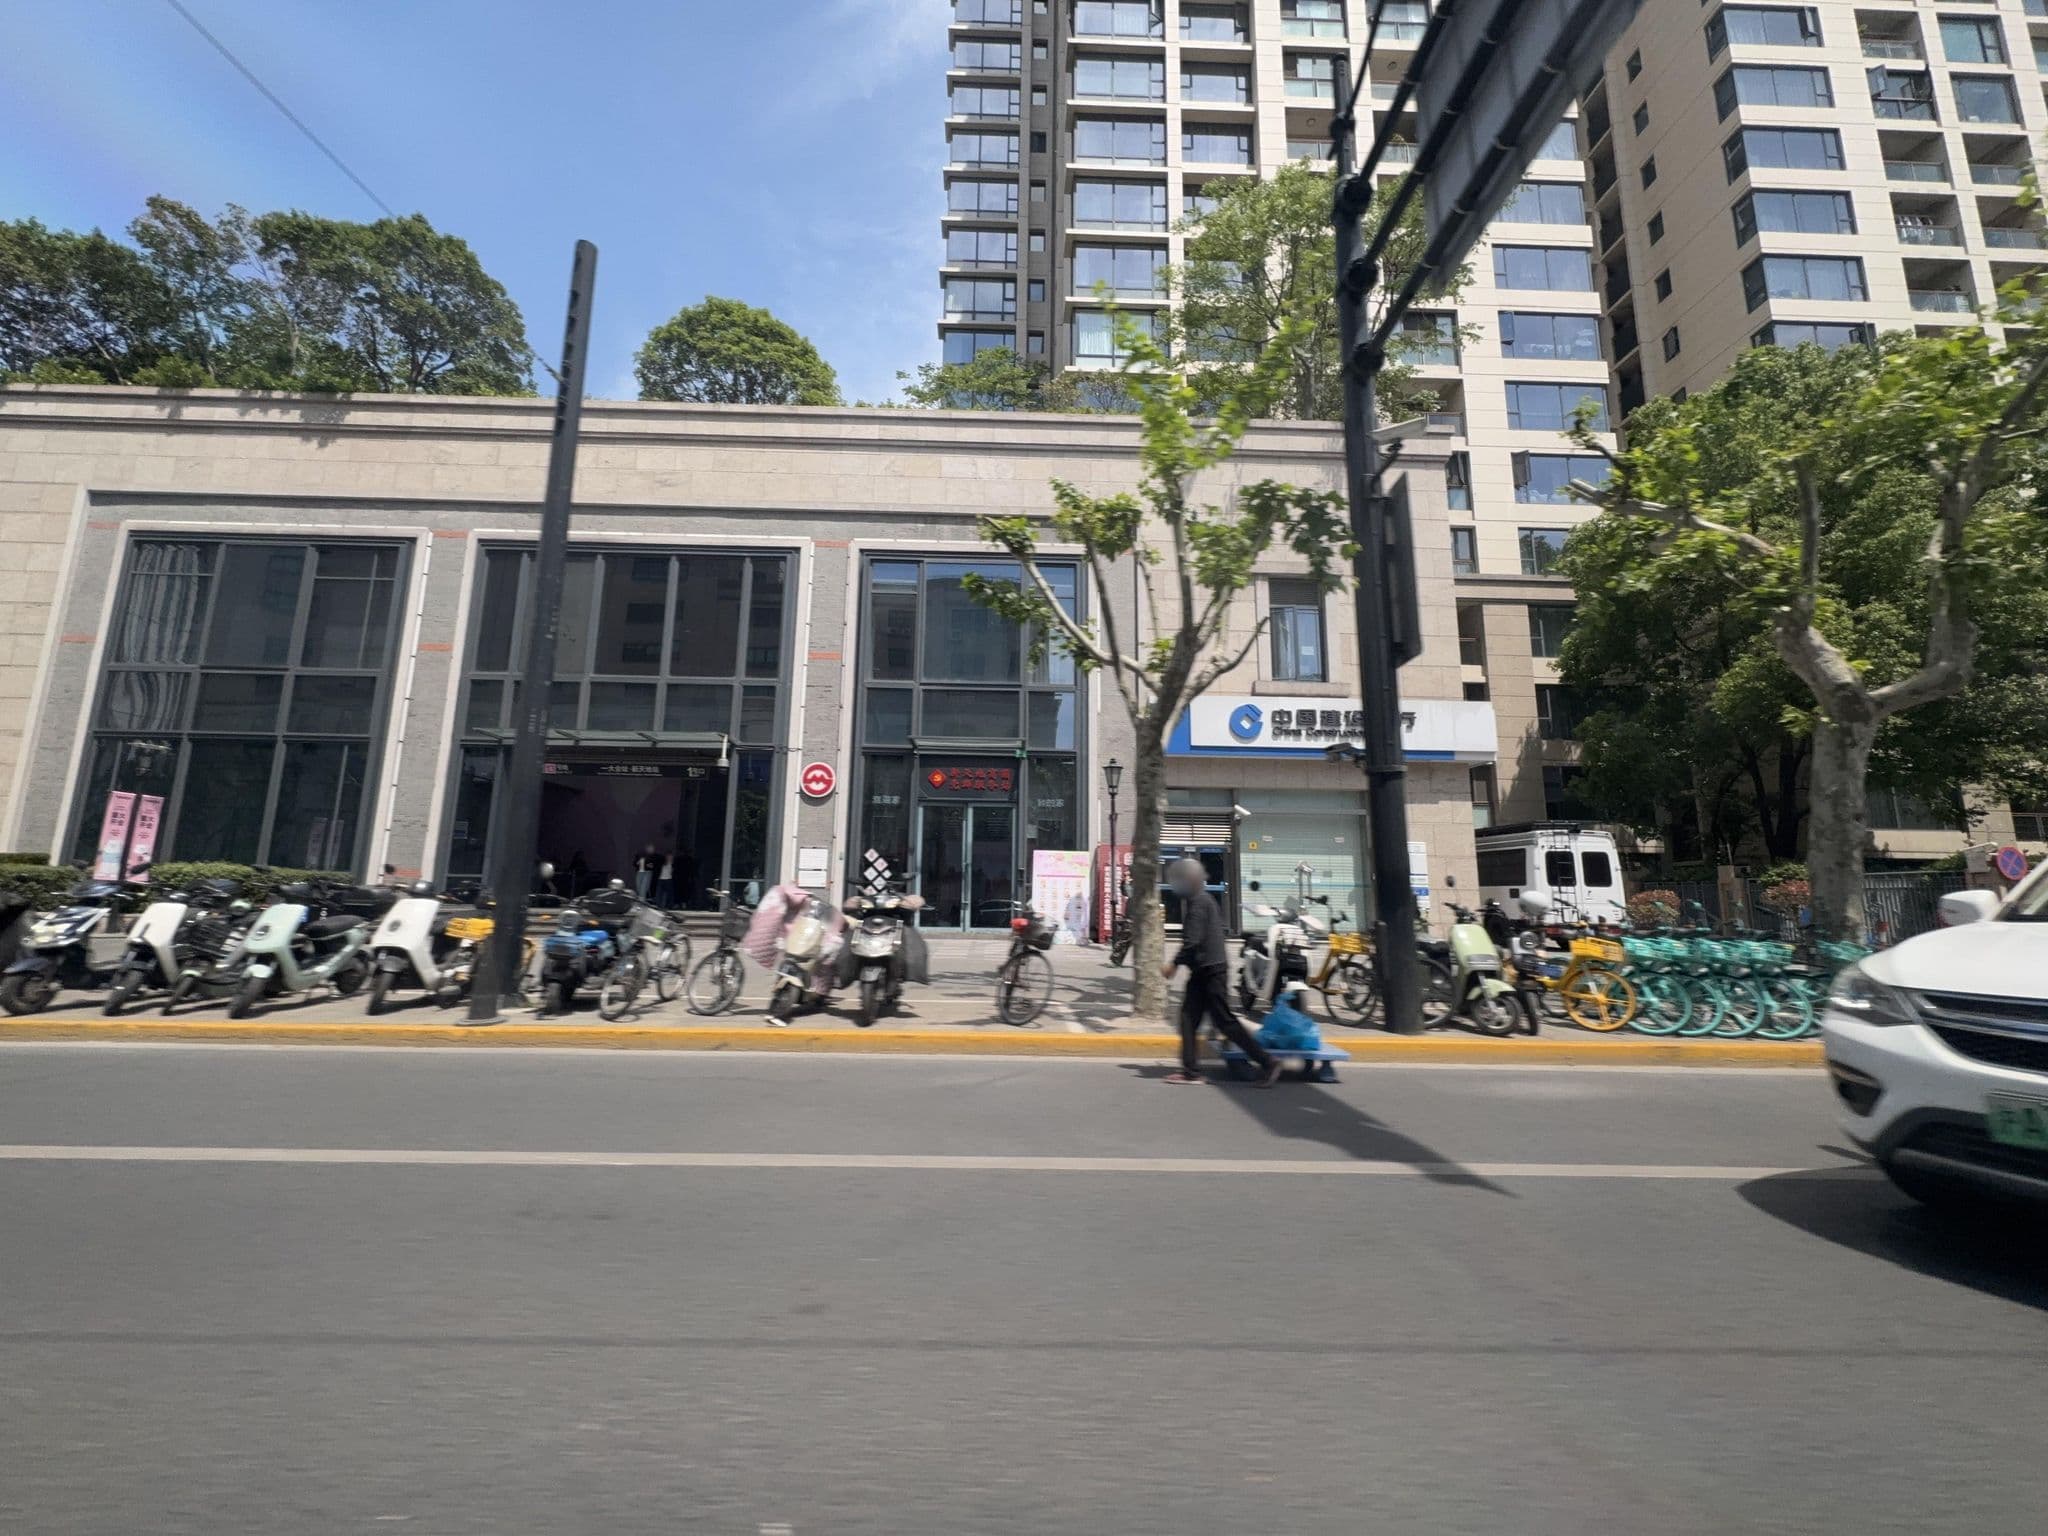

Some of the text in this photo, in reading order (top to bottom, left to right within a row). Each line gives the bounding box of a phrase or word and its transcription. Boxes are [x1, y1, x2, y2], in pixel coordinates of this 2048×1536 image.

[1271, 709, 1416, 729] 中国建设行
[1272, 727, 1301, 738] China
